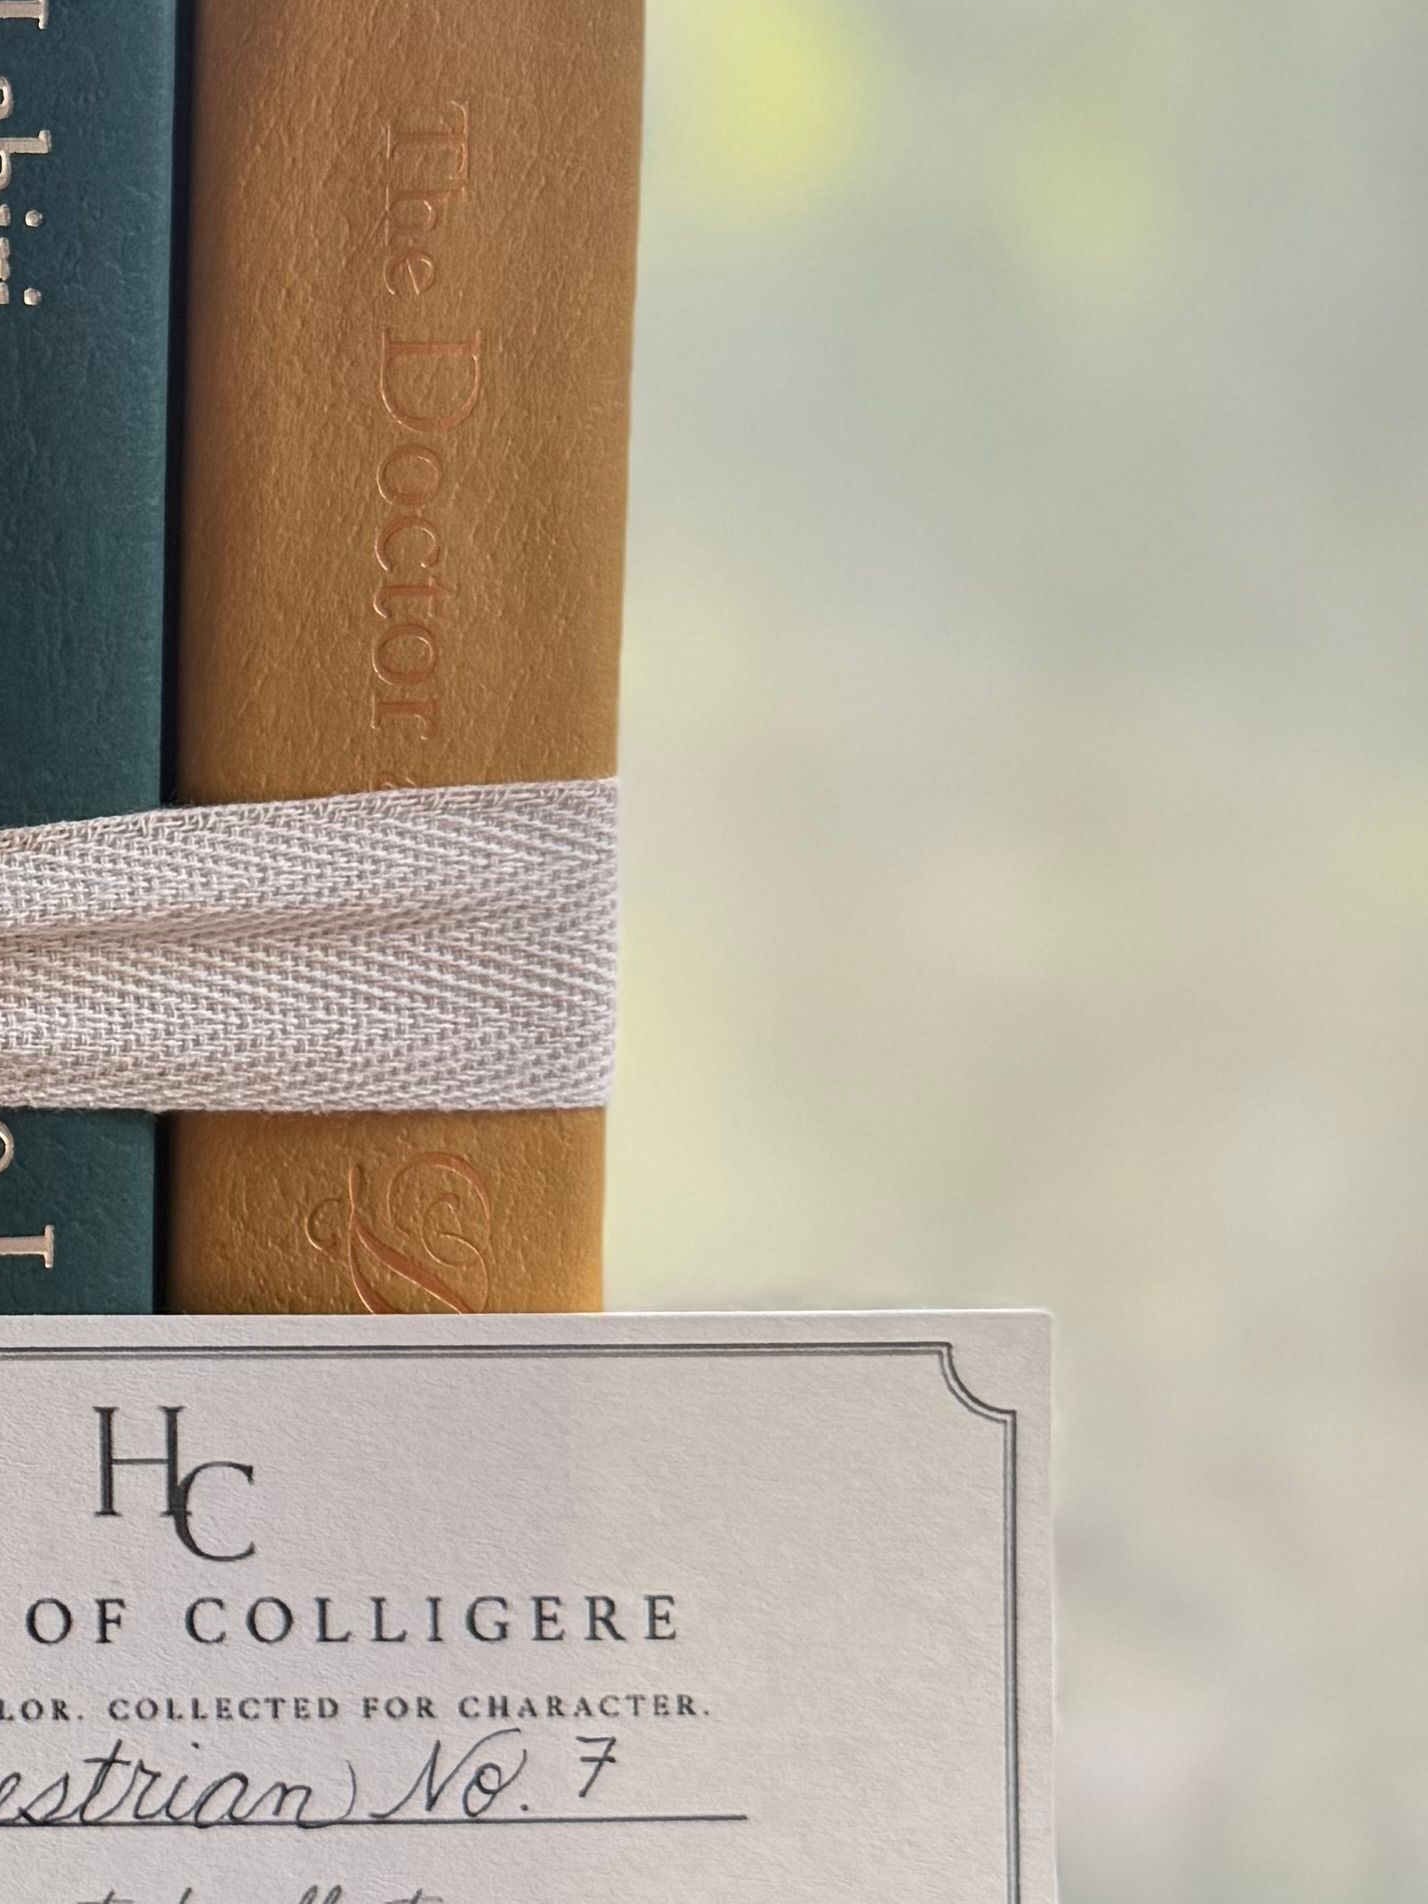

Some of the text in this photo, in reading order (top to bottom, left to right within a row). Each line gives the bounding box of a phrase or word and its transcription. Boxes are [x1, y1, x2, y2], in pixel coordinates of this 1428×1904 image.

[380, 99, 471, 299] The
[369, 329, 484, 739] Doctor
[24, 1597, 127, 1646] OF
[183, 1594, 677, 1646] COLLIGERE
[106, 1696, 341, 1722] COLLECTED
[361, 1695, 437, 1721] FOR
[457, 1692, 712, 1720] CHARACTER.
[369, 1728, 531, 1824] No.
[576, 1734, 618, 1799] 7
